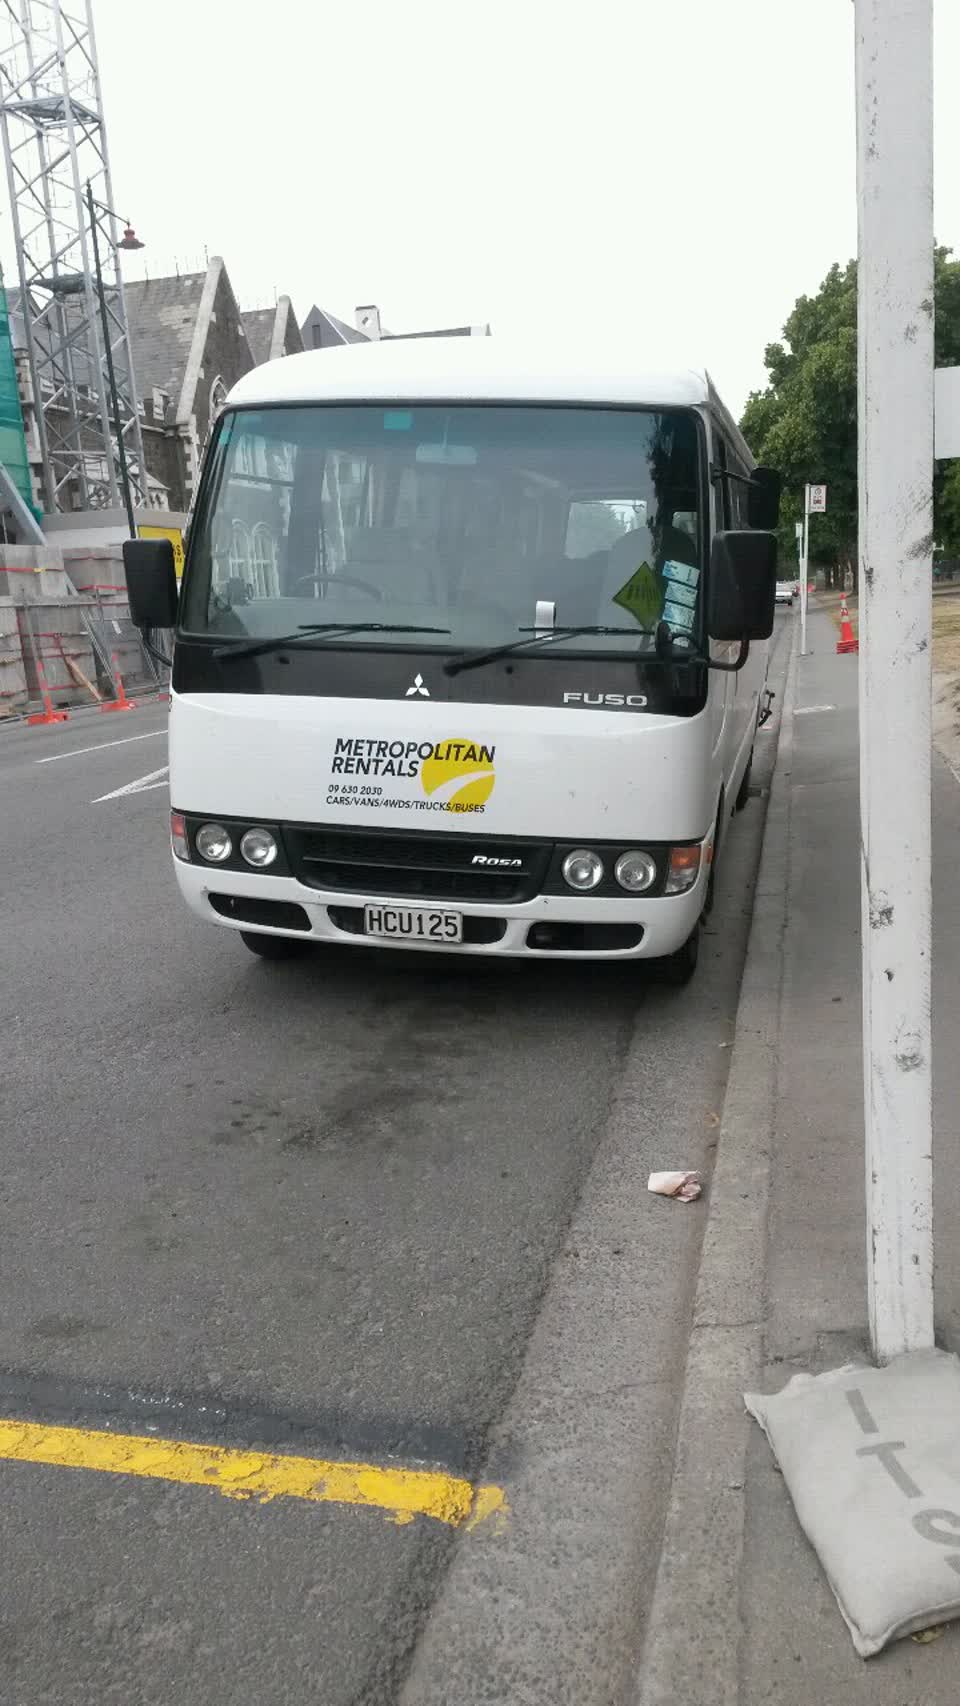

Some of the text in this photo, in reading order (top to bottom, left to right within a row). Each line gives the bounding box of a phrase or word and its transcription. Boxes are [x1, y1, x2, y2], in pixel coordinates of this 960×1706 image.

[563, 692, 648, 706] FUSO
[334, 738, 496, 763] METROPOLITAN
[331, 756, 419, 778] RENTALS
[328, 784, 383, 796] 09 630 2030
[326, 795, 486, 814] CARS/VANS/4WDS/TRUCKS/BUSES
[368, 909, 458, 938] HCU125
